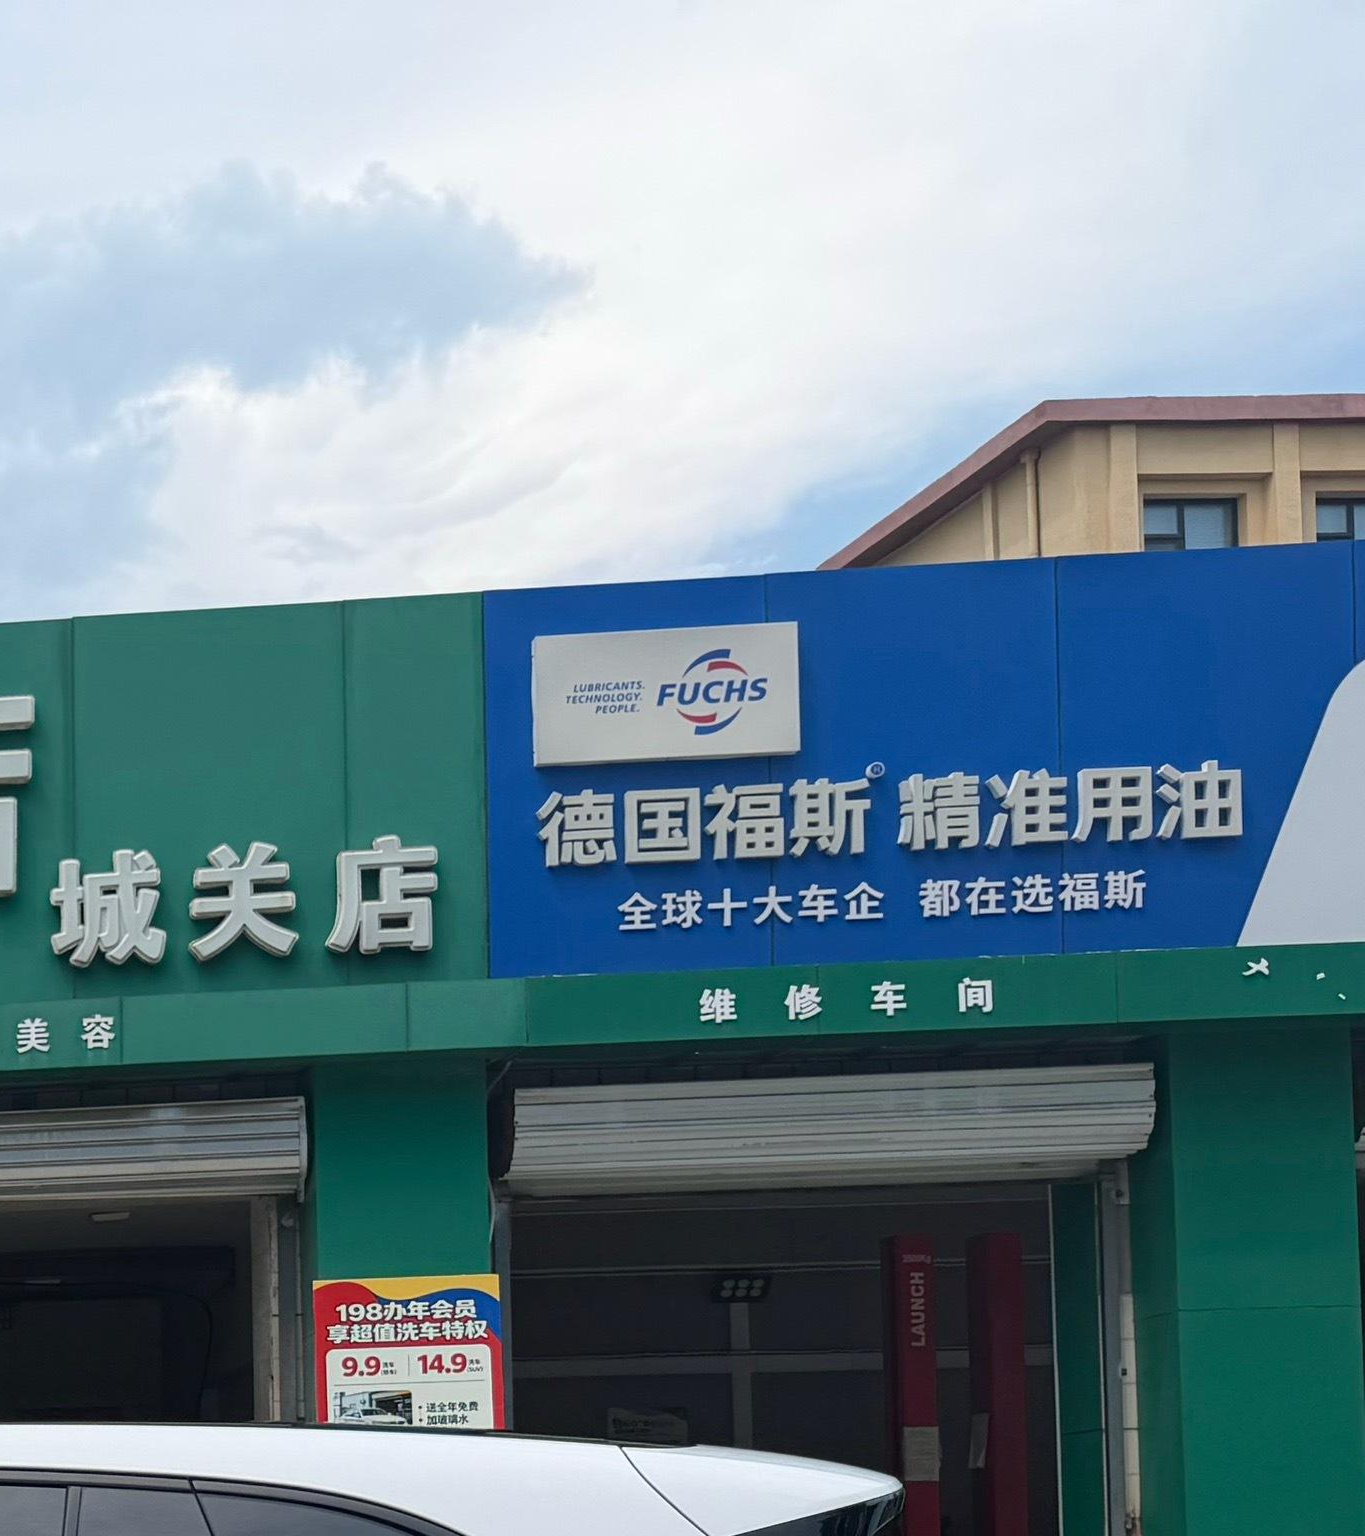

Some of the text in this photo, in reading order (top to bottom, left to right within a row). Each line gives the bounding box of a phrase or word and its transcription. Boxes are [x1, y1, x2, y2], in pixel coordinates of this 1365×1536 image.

[566, 692, 643, 705] TECHNOLOGY.
[573, 680, 645, 694] LUBRICANTS.
[656, 677, 769, 706] FUCHS
[595, 703, 640, 715] PEOPLE.
[535, 759, 1244, 868] 德国福斯 精准用油
[50, 834, 438, 969] 城关店
[617, 869, 1147, 932] 全球十大车企 都在选福斯
[700, 976, 994, 1025] 维修车间
[335, 1299, 478, 1323] 198办年会员
[909, 1271, 926, 1347] LAUNCH
[326, 1319, 489, 1345] 享超值洗车特权
[341, 1355, 381, 1377] 9.9
[417, 1353, 467, 1375] 14.9
[426, 1401, 479, 1413] 送全年免费
